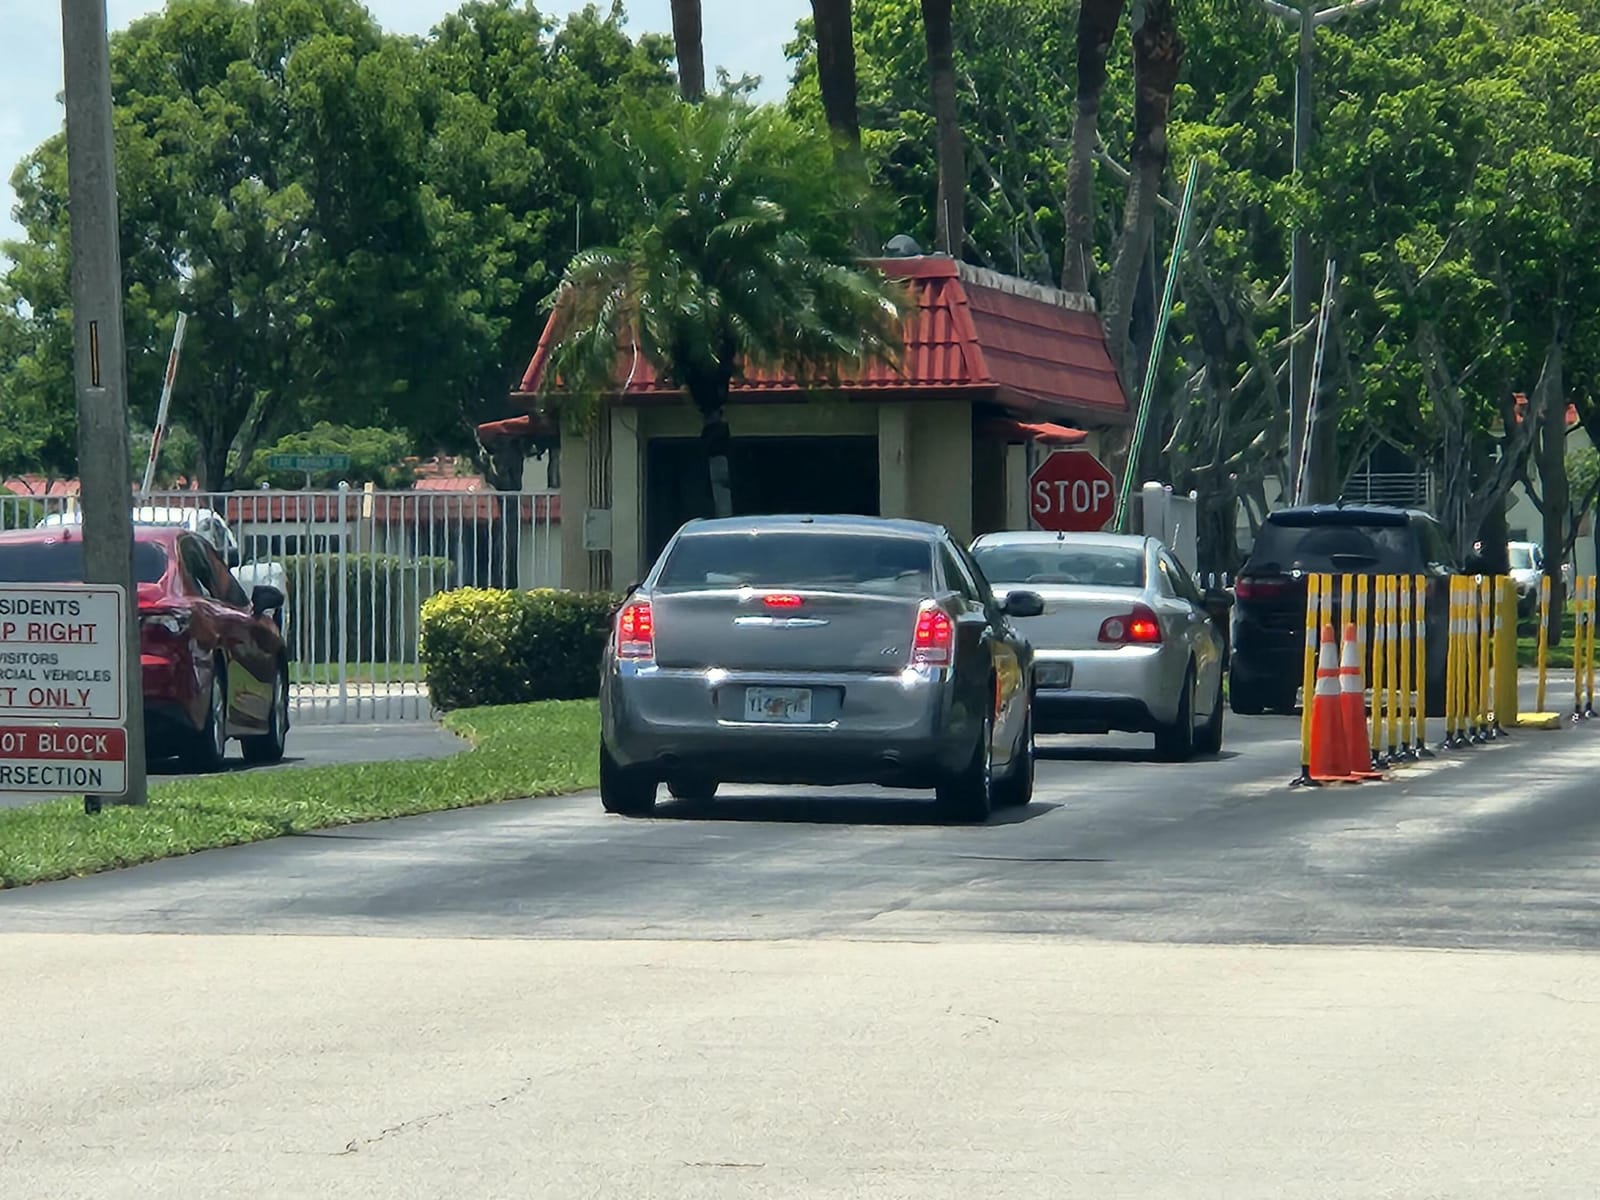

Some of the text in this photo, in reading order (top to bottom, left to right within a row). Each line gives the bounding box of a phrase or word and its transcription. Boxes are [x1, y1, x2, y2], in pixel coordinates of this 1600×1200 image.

[1034, 480, 1110, 514] STOP
[0, 599, 81, 616] SIDENTS
[0, 622, 97, 642] P RIGHT
[42, 669, 112, 682] VEHICLES
[0, 687, 91, 707] T ONLY
[38, 733, 108, 753] BLOCK
[0, 765, 102, 786] RSECTION
